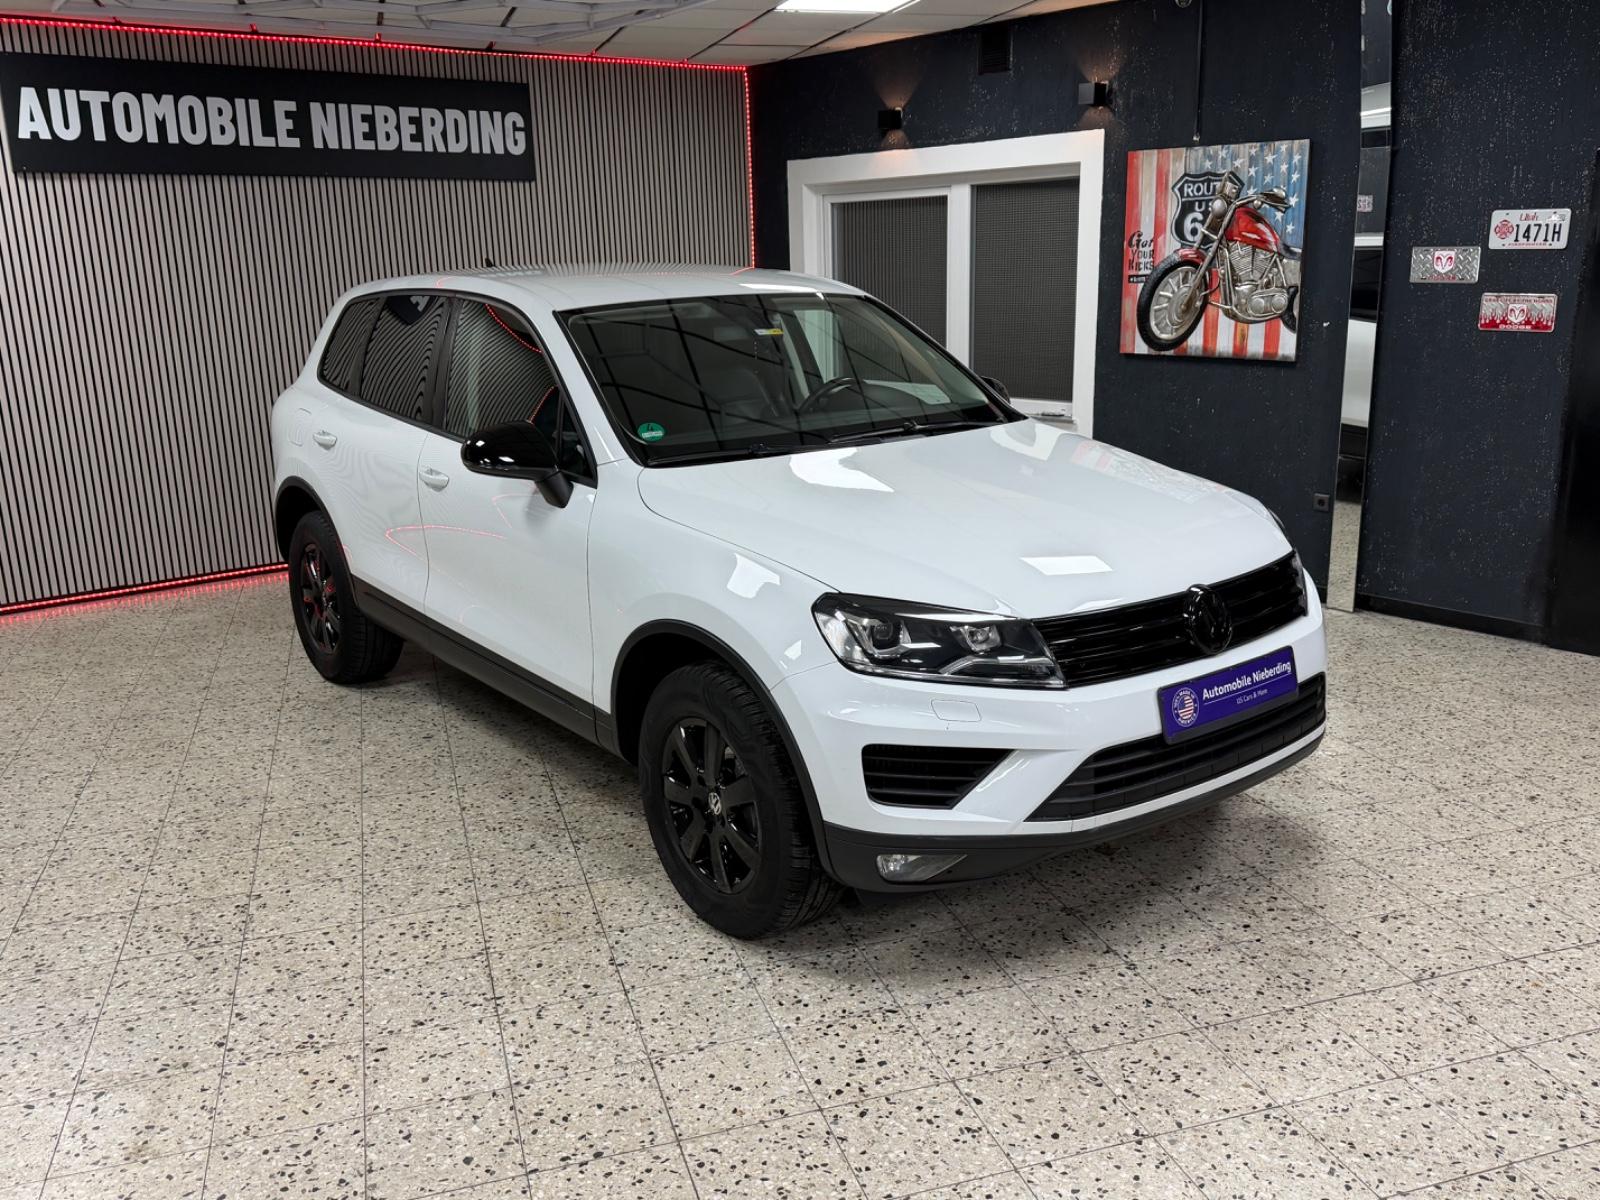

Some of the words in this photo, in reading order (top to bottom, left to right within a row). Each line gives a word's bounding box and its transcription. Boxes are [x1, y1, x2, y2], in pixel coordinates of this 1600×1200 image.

[17, 86, 301, 148] AUTOMOBILE
[310, 101, 527, 156] NIEBERDING
[1184, 181, 1220, 197] ROUT
[1513, 222, 1562, 242] 1471H
[1131, 249, 1155, 259] YOUR
[1128, 257, 1155, 271] KICKS
[1202, 674, 1252, 700] Automobile
[1252, 661, 1292, 683] Nieberding
